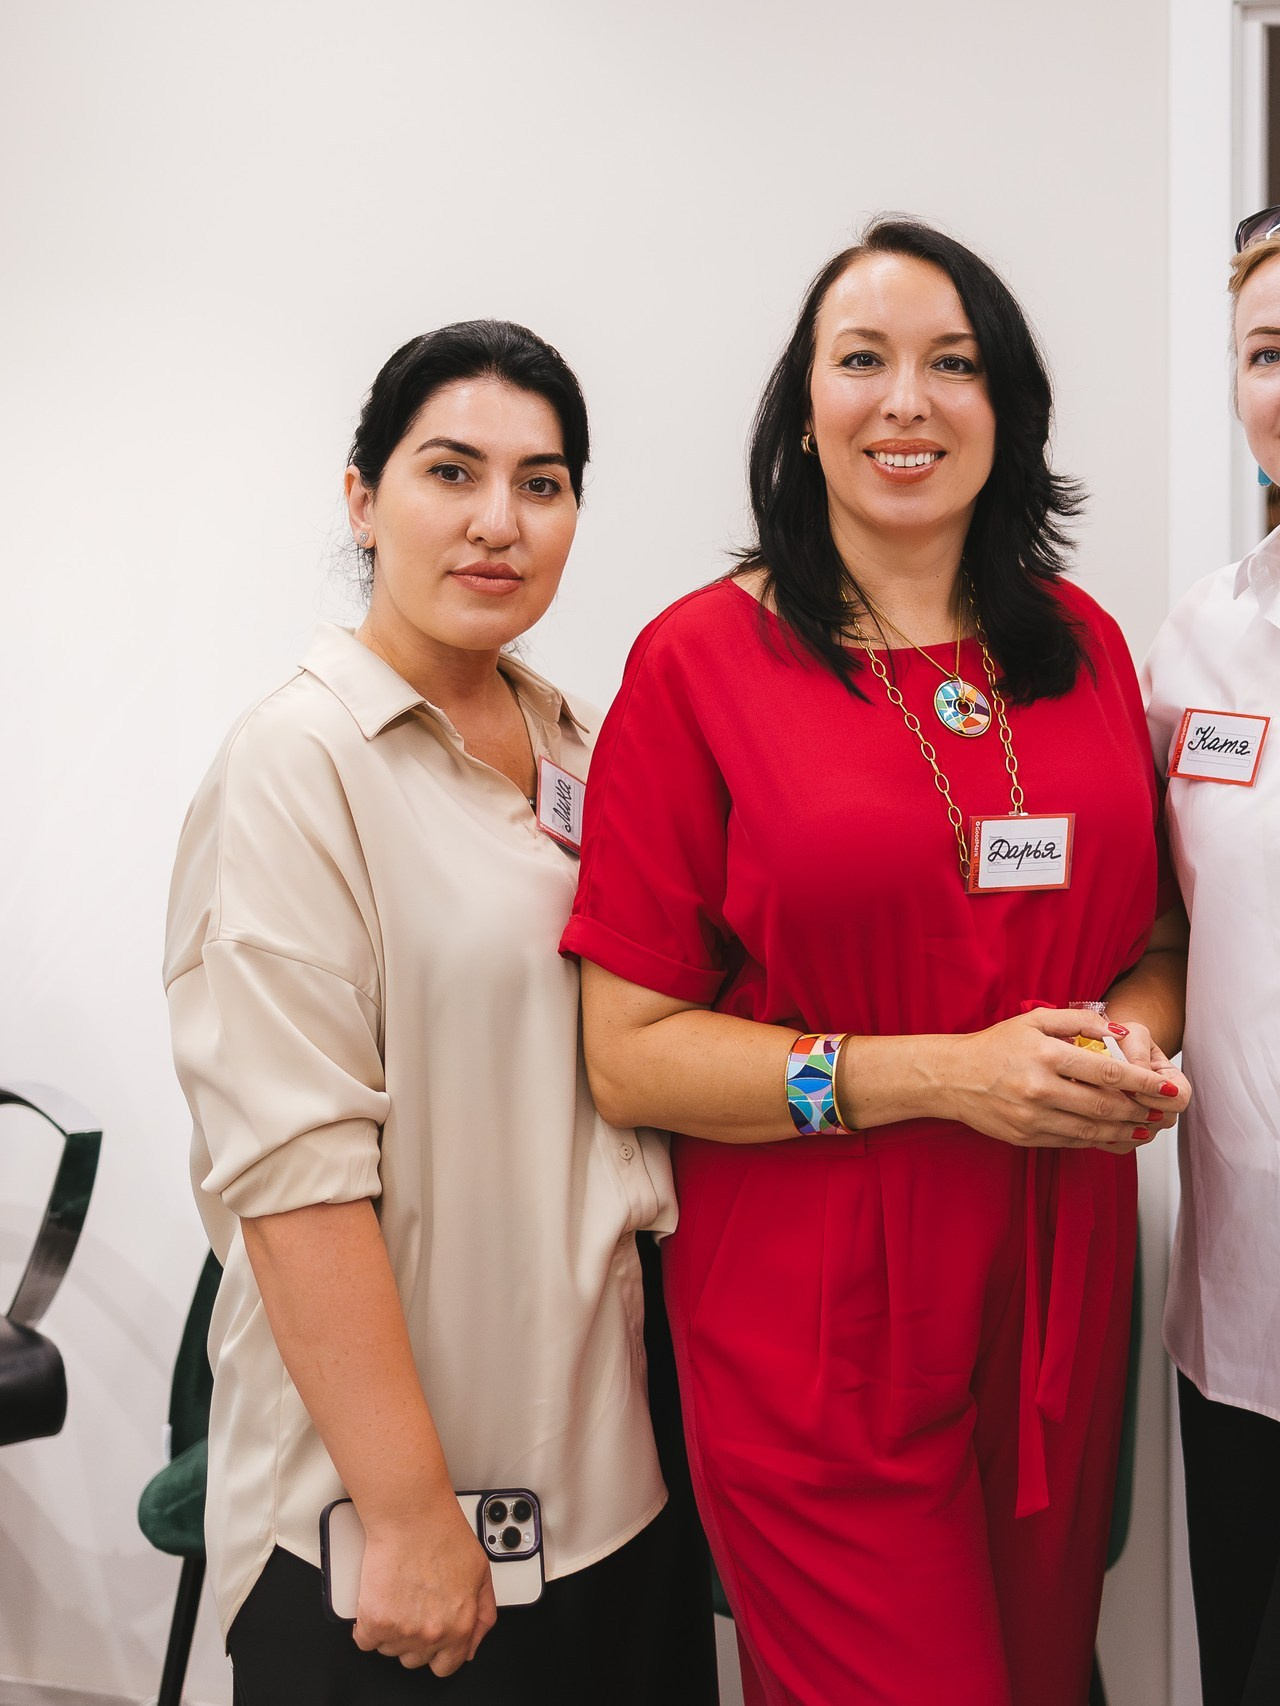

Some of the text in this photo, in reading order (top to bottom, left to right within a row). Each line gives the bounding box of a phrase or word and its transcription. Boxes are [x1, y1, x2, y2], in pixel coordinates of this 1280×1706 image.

[1187, 725, 1251, 756] Катя
[973, 826, 981, 857] GoodMark
[987, 838, 1062, 870] Дарья
